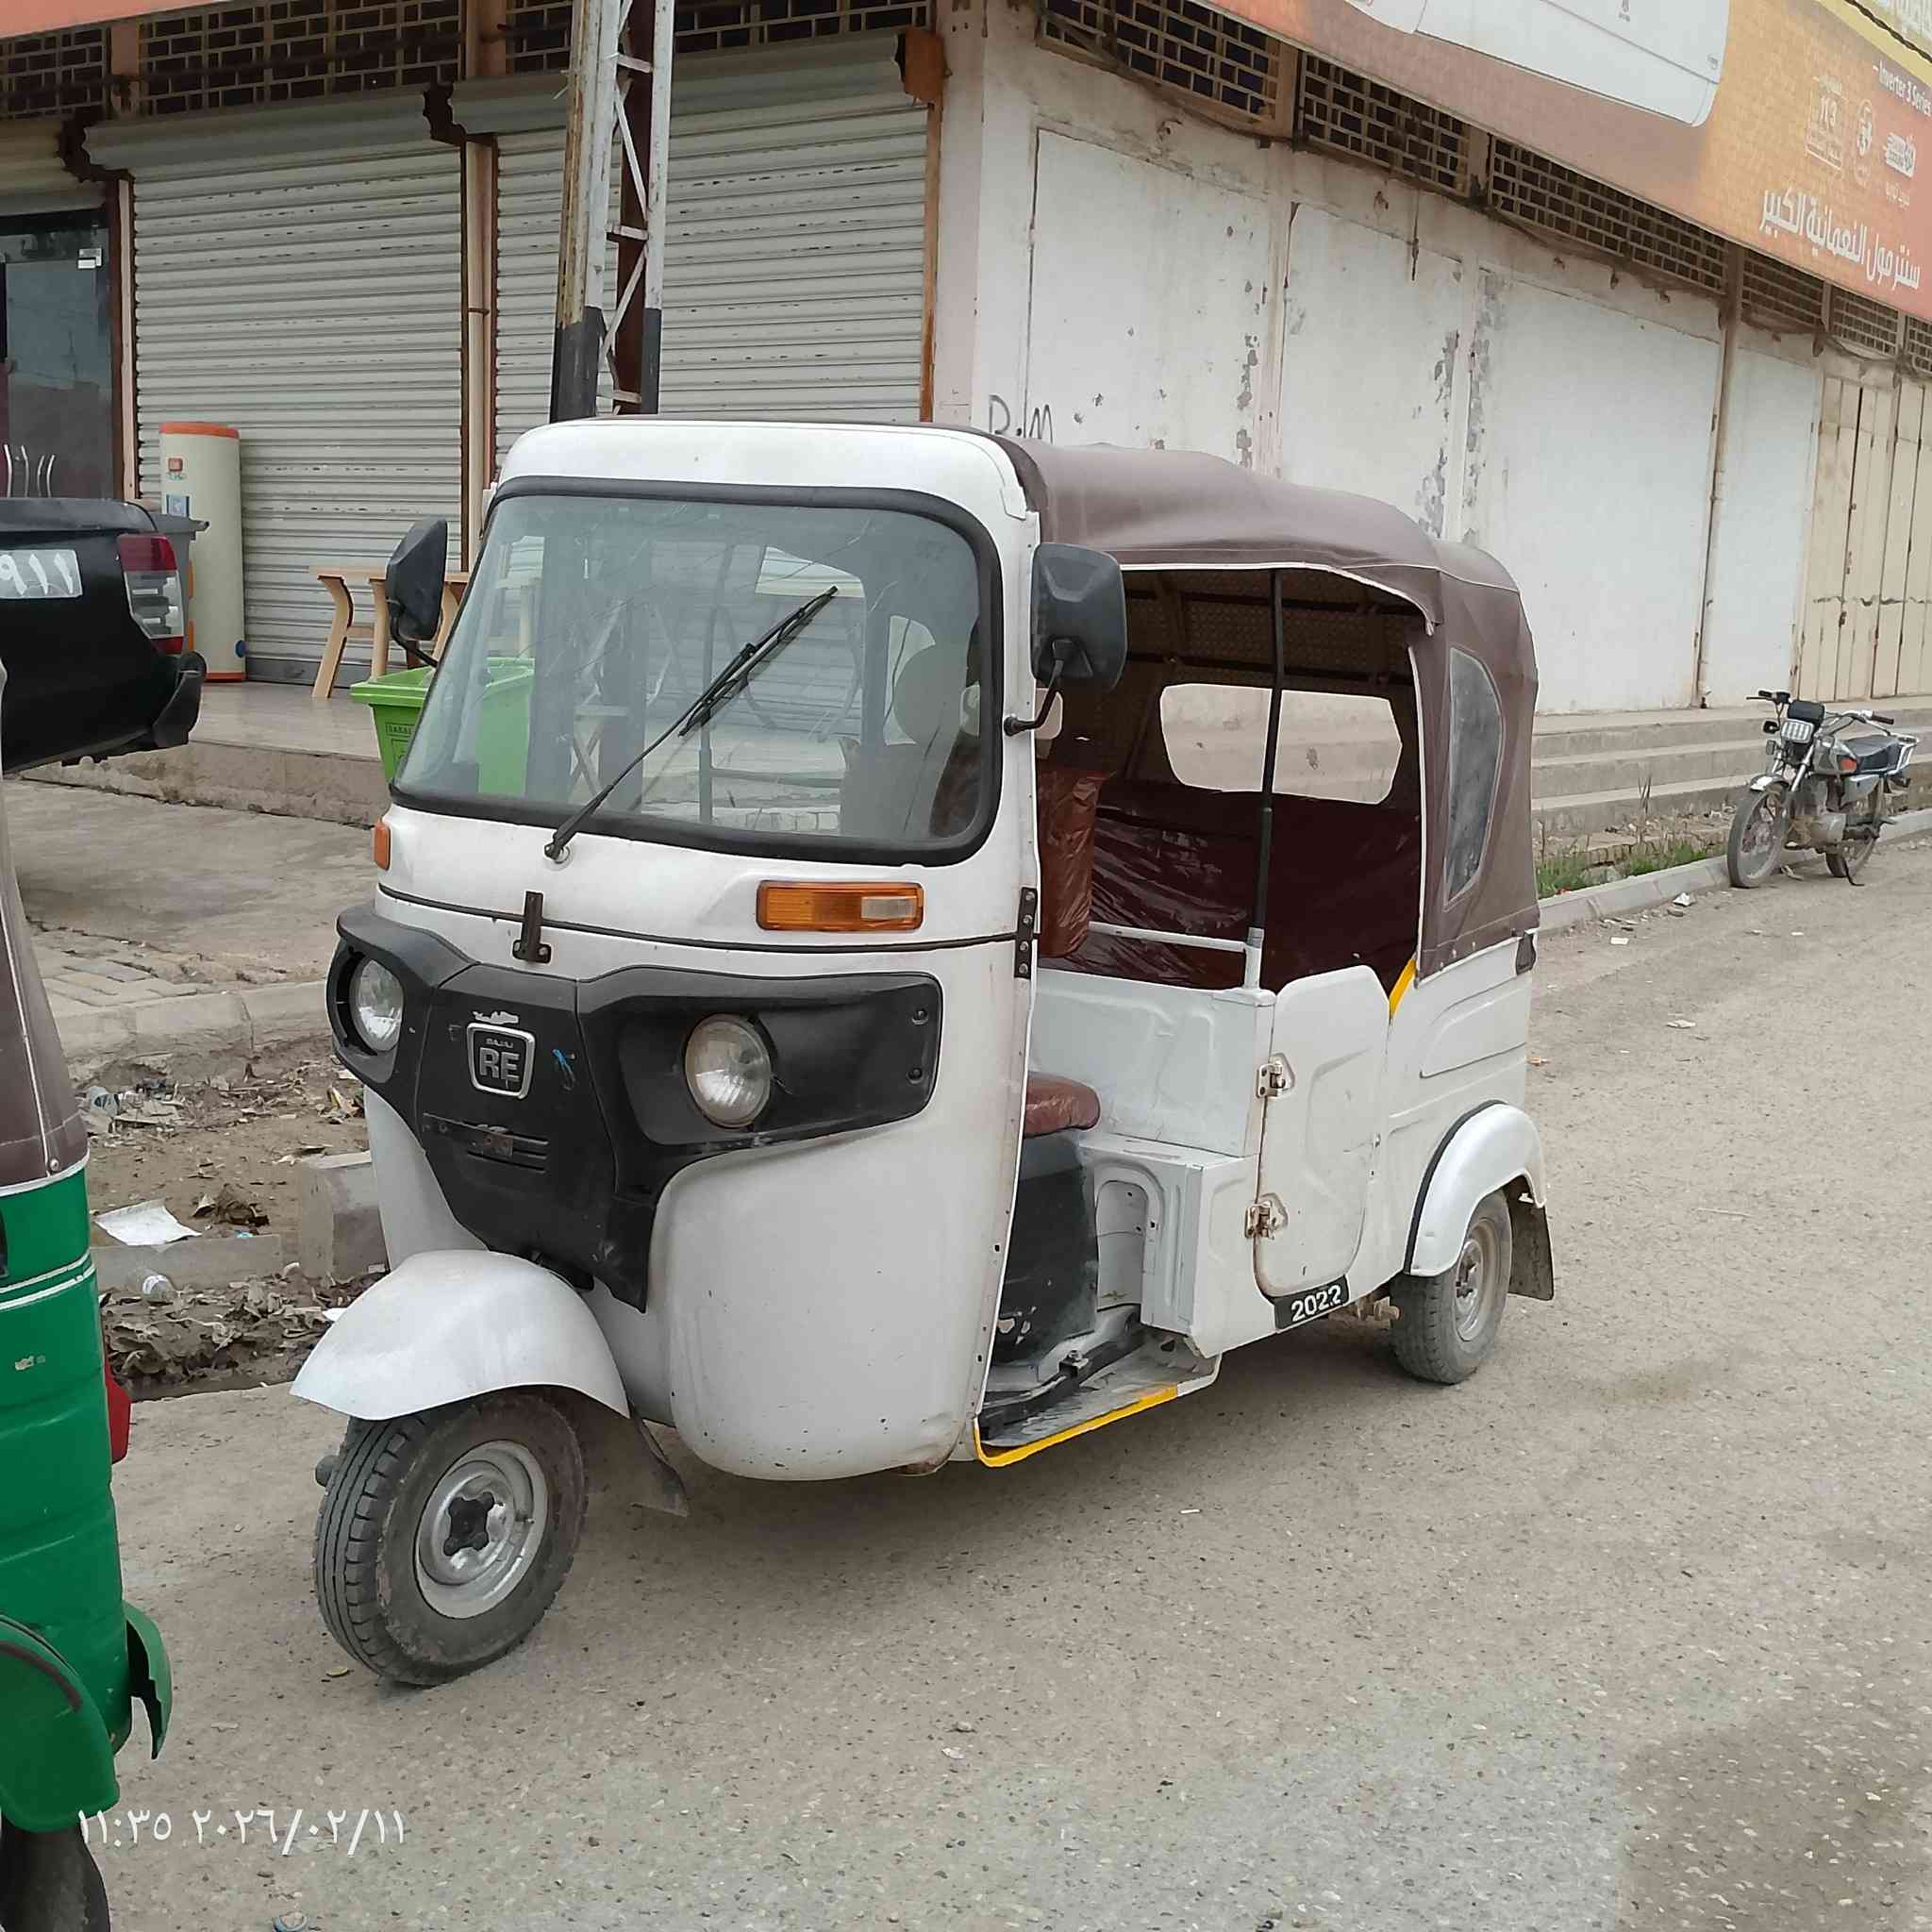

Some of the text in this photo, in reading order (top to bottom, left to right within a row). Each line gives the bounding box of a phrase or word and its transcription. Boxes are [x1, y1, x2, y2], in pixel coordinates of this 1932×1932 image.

[1758, 187, 1806, 239] الكبير
[1806, 194, 1868, 265] النعمانية
[1866, 233, 1894, 285] مول
[1891, 244, 1921, 291] سنتر
[479, 1047, 520, 1082] RE
[1291, 1284, 1341, 1322] 2022
